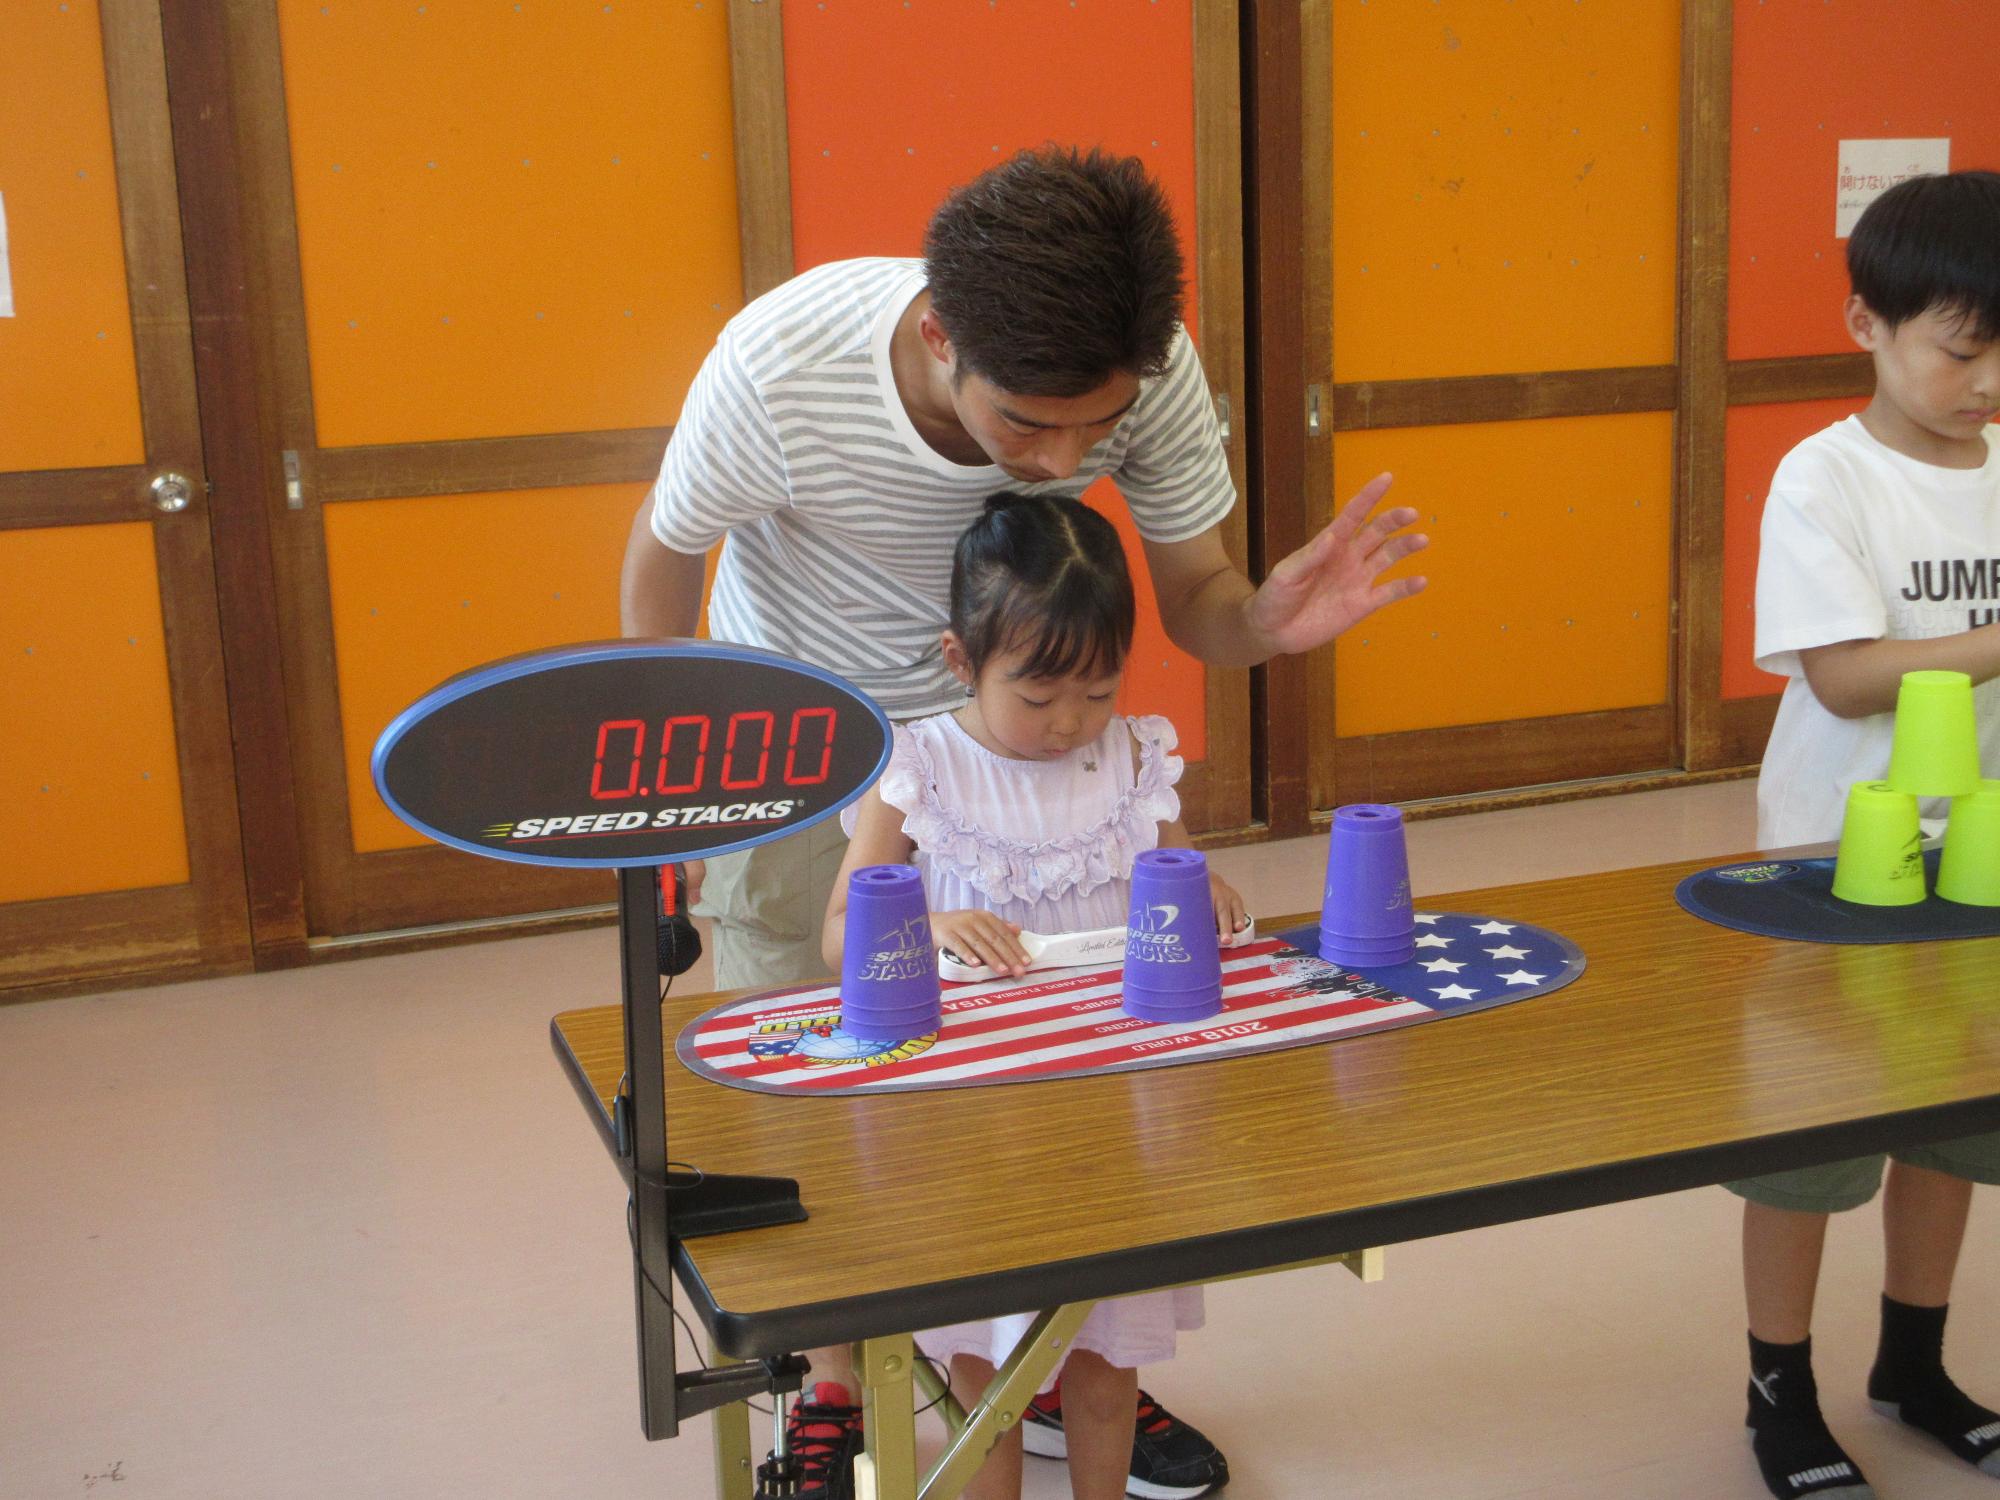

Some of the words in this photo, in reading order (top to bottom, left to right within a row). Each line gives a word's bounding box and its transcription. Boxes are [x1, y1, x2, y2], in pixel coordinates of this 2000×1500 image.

[590, 707, 837, 799] 0.000
[512, 810, 649, 839] SPEED
[652, 799, 794, 828] STACKS
[1126, 940, 1192, 962] ACKS
[942, 997, 992, 1011] USA
[1200, 1021, 1269, 1041] 2018
[1132, 1035, 1197, 1052] WORLD
